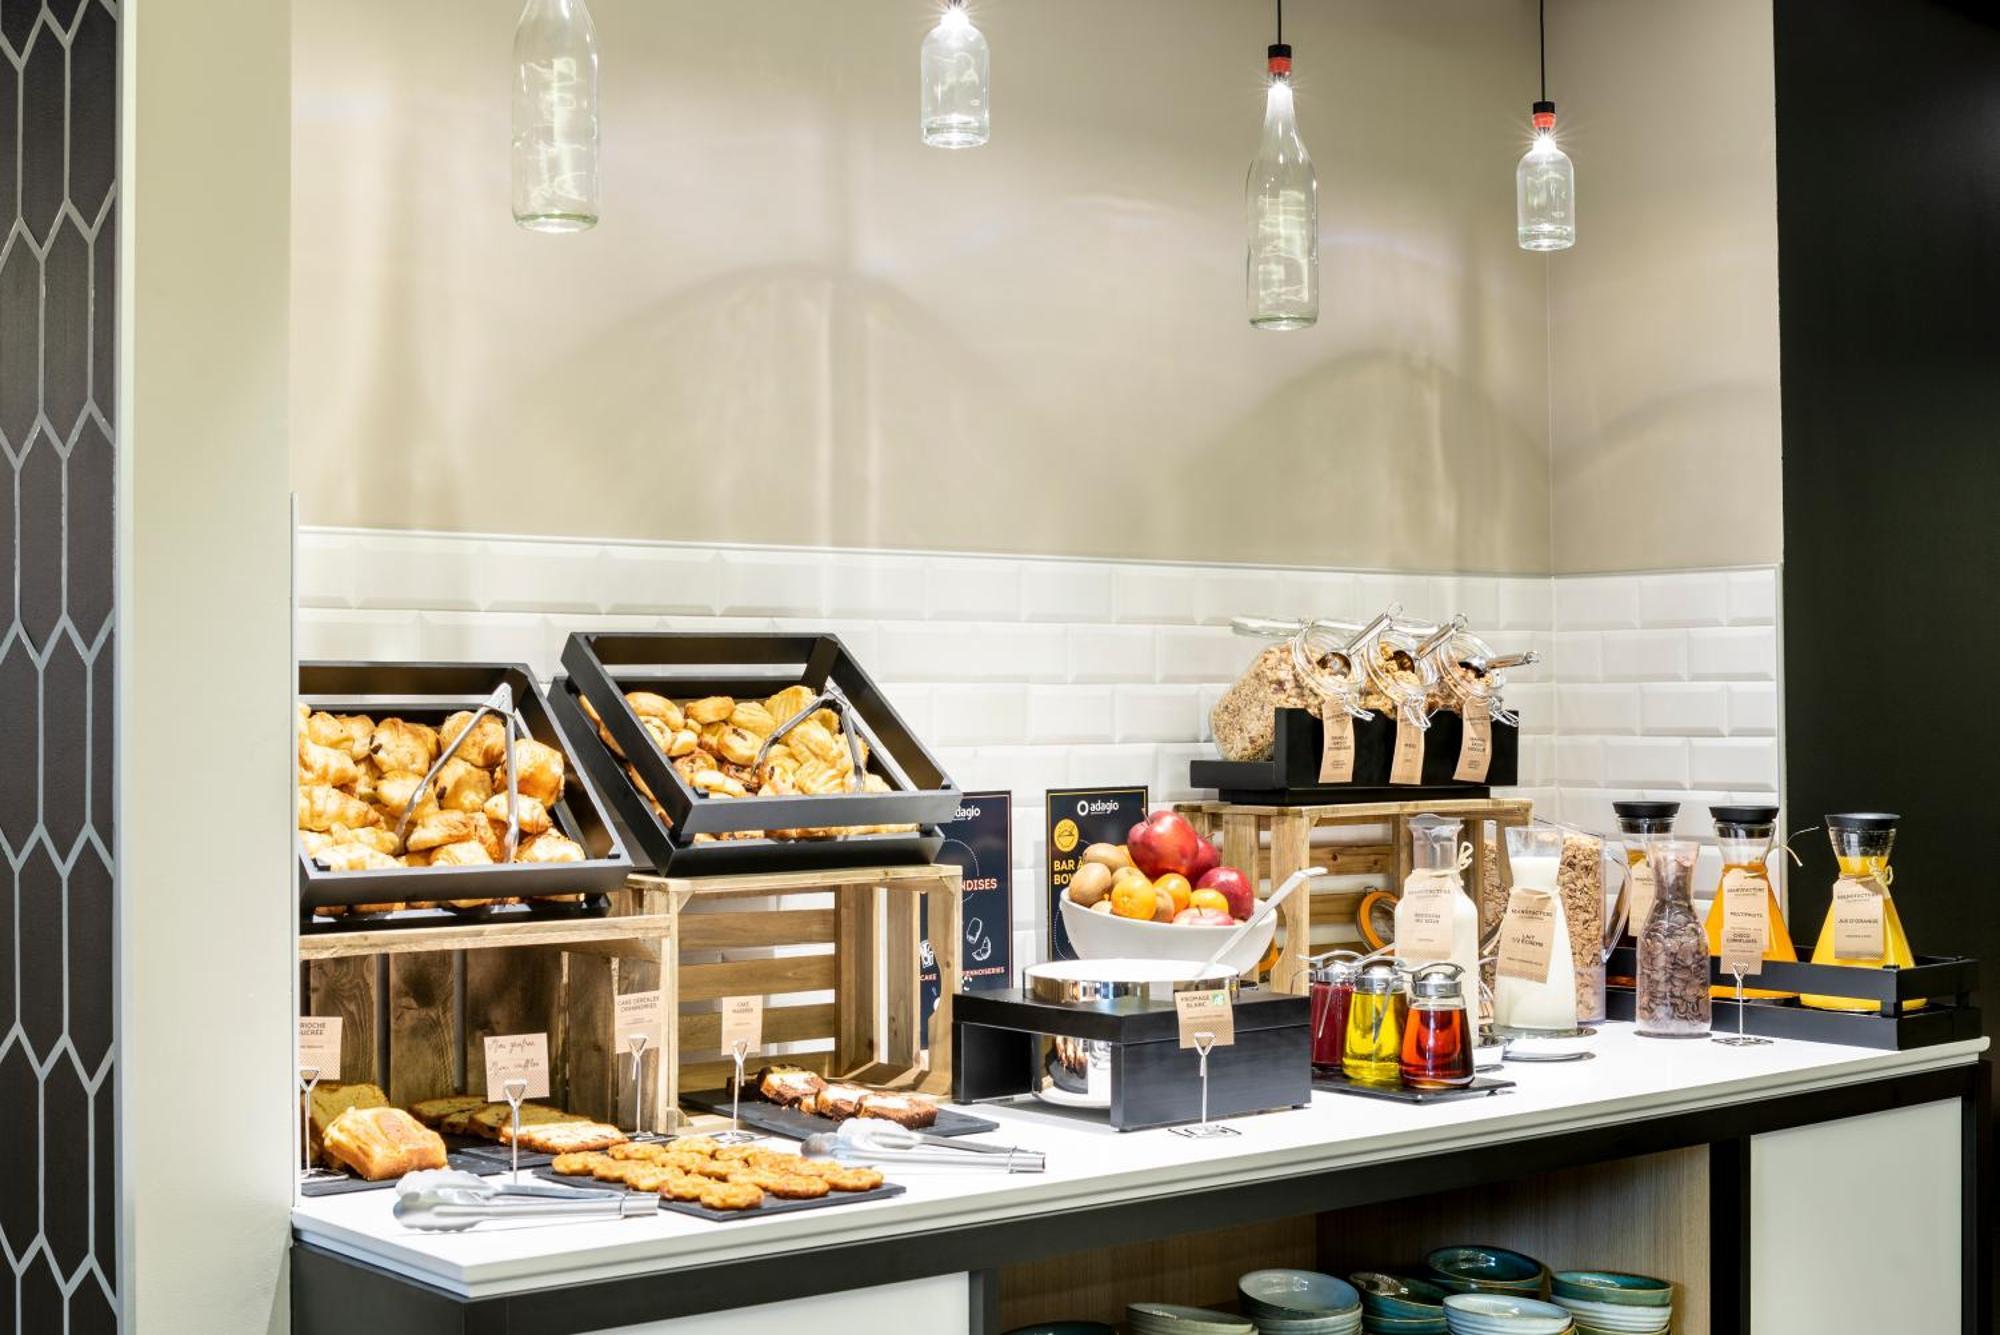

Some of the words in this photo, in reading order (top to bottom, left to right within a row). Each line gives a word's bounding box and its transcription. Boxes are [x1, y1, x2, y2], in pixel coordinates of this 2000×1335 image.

[955, 805, 980, 820] dagio
[1090, 800, 1119, 814] adagio
[1054, 860, 1075, 871] BAR
[960, 878, 998, 891] NDISES
